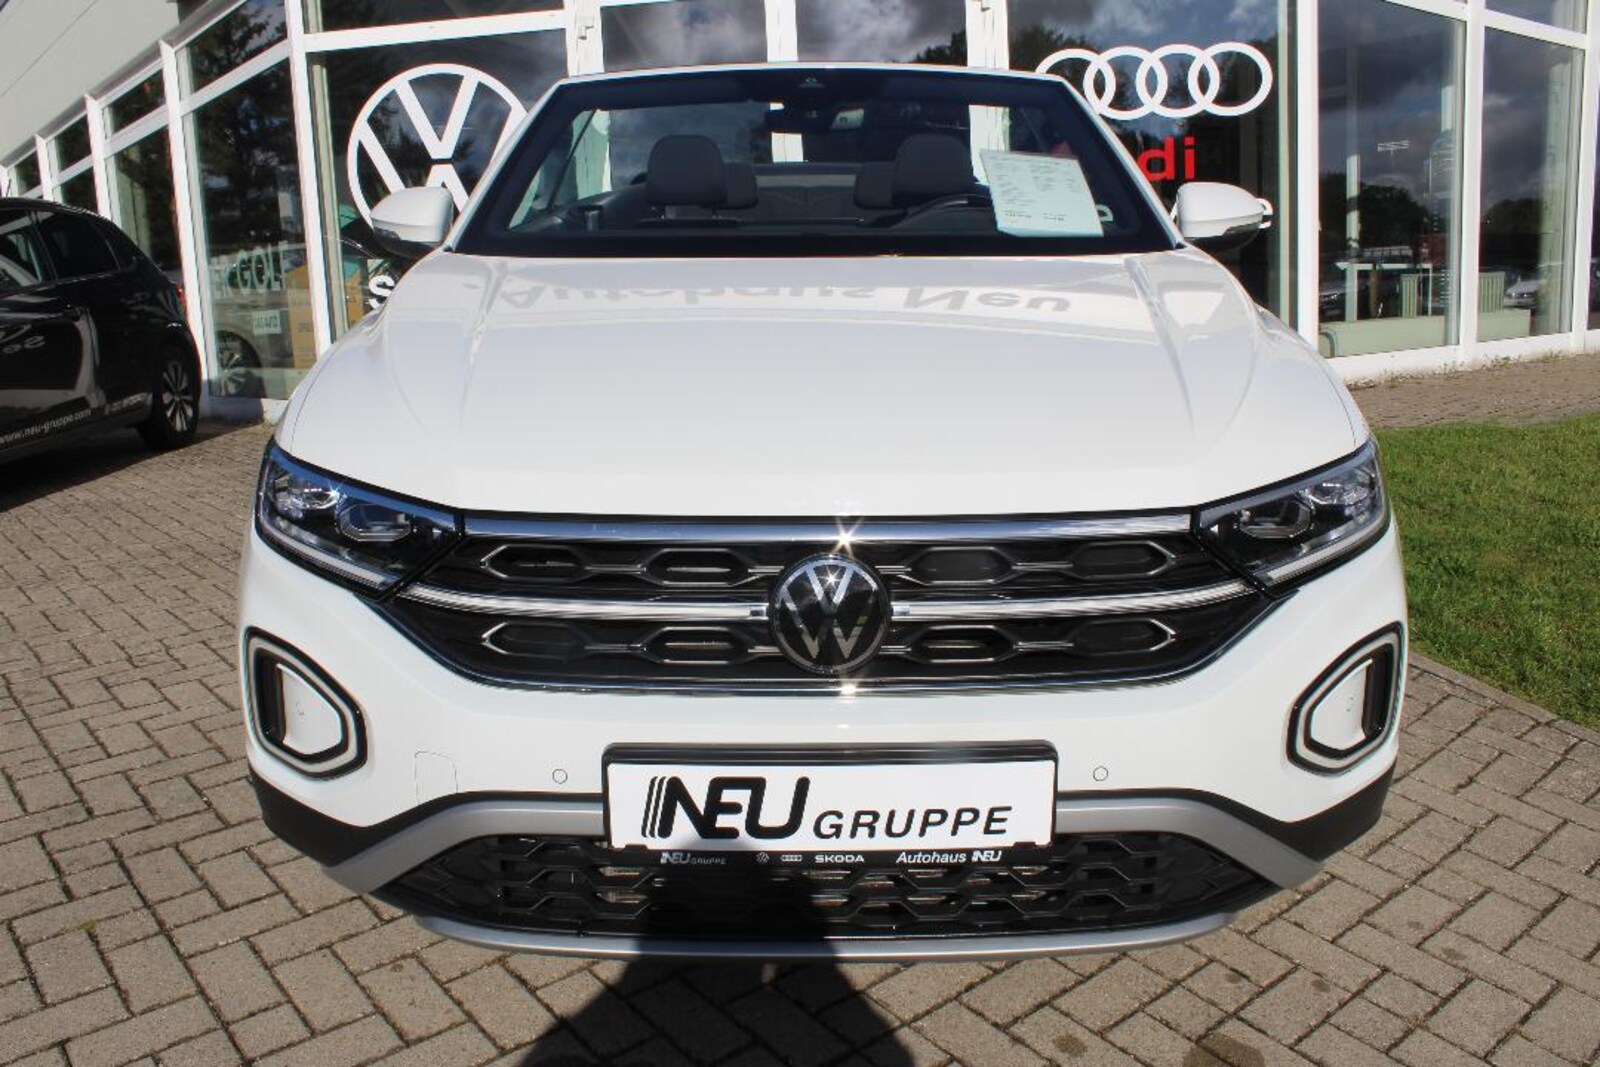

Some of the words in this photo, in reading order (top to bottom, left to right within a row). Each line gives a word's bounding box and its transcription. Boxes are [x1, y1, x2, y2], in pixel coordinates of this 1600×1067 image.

[1138, 135, 1196, 182] di
[641, 776, 811, 839] NEU
[812, 805, 1013, 839] GRUPPE
[660, 851, 691, 865] NEU
[896, 850, 967, 864] Autohaus
[972, 850, 1002, 863] NEU
